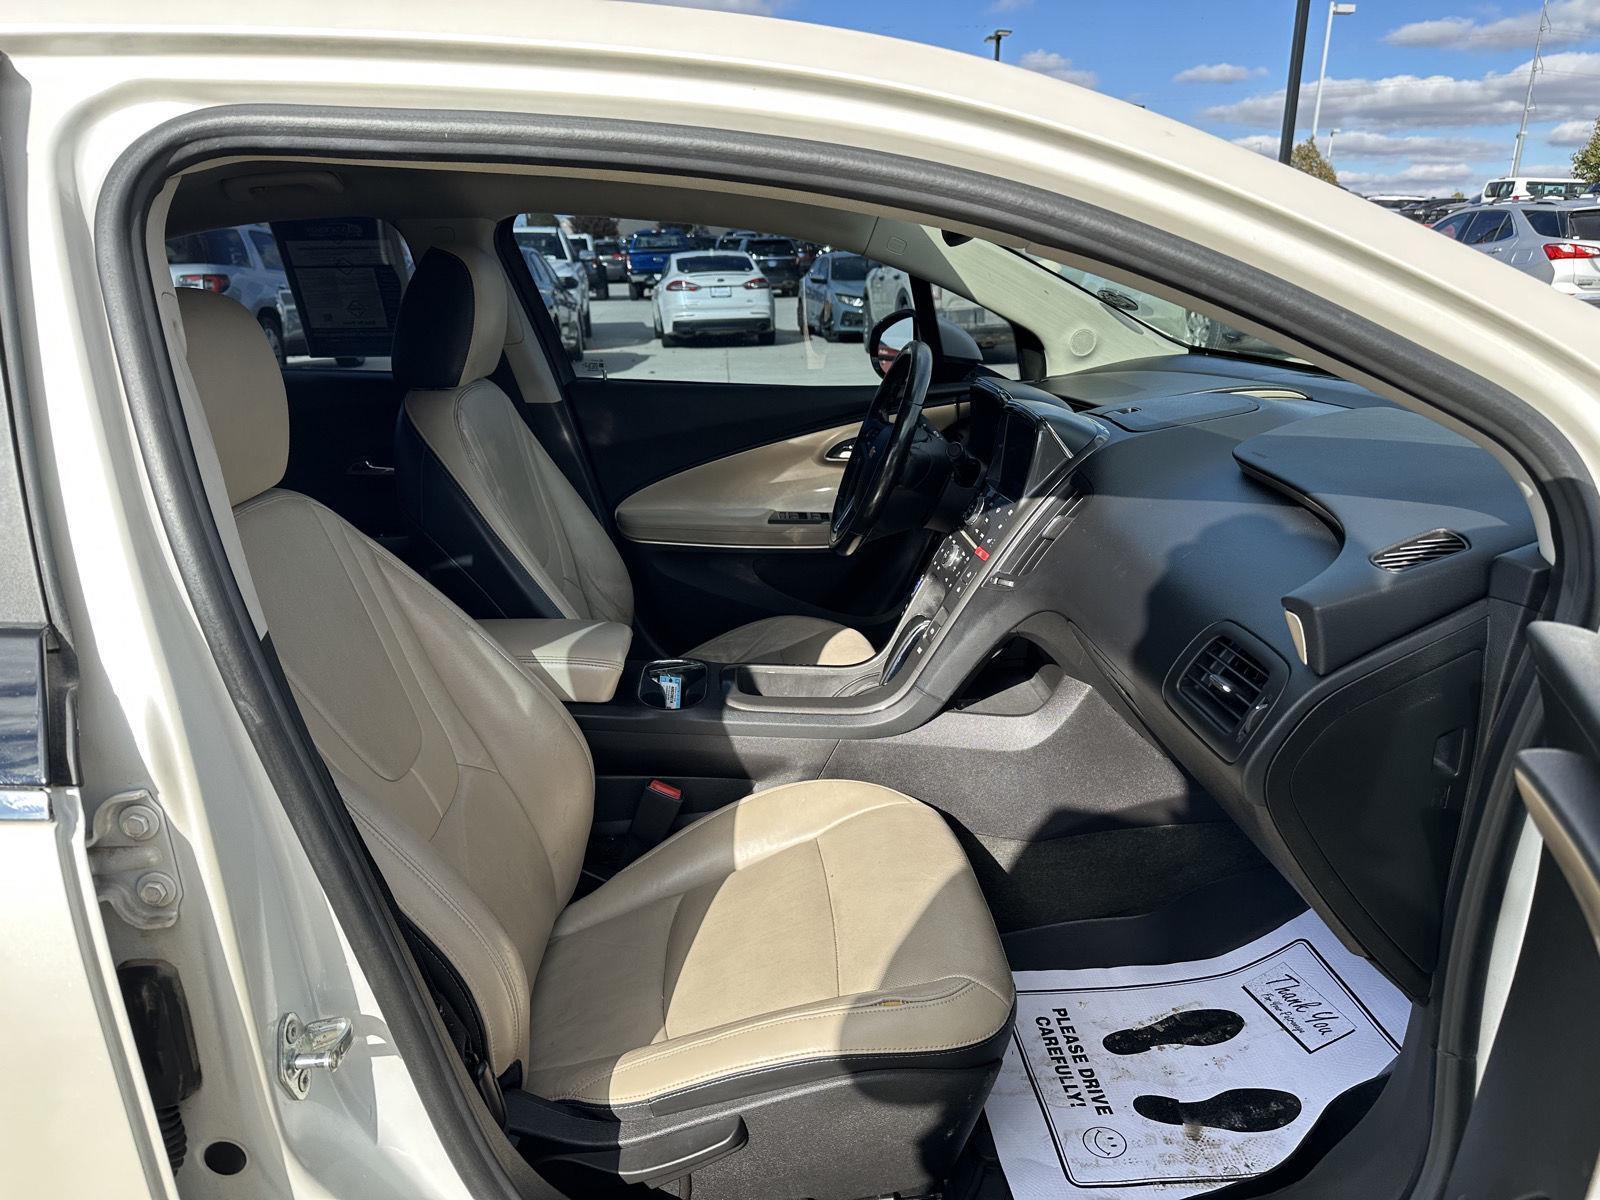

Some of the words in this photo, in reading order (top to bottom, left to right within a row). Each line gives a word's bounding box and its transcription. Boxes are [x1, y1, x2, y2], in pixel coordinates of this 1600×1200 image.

[1266, 973, 1322, 1012] Thank
[1305, 1011, 1339, 1036] You
[1035, 1016, 1087, 1108] CAREFULLY!
[1052, 1008, 1090, 1064] PLEASE
[1077, 1068, 1114, 1116] DRIVE
